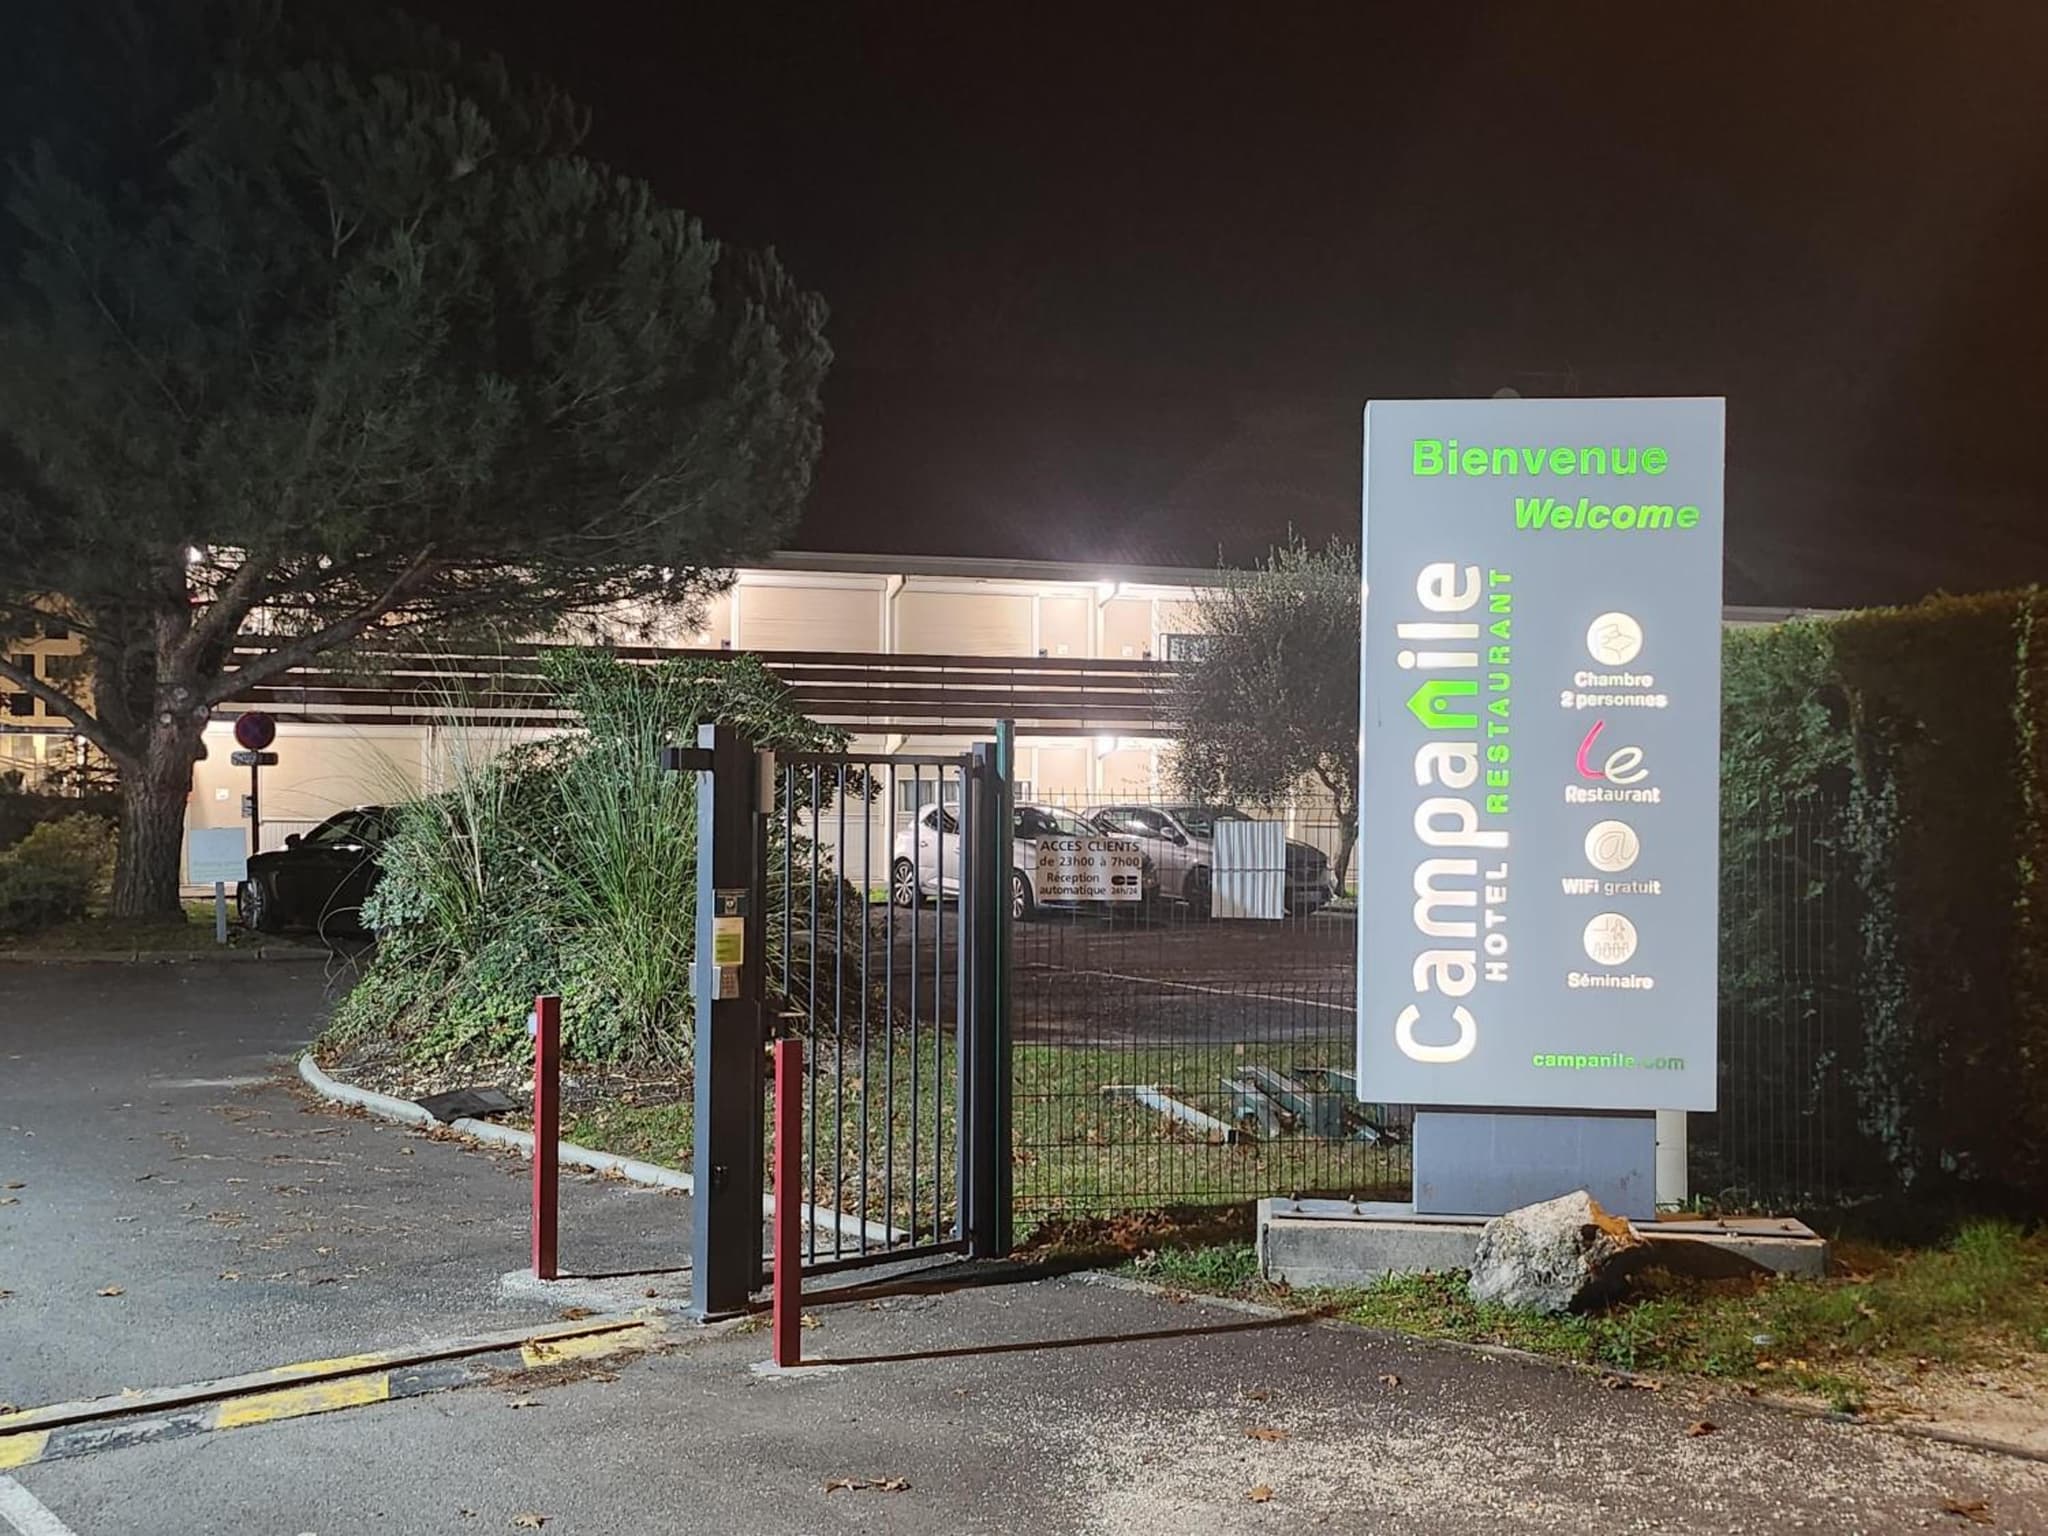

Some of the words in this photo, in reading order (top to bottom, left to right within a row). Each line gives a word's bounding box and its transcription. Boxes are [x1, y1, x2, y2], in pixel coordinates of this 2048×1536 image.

[1411, 439, 1669, 477] Bienvenue
[1514, 498, 1700, 530] Welcome
[1574, 671, 1654, 688] Chambre
[1485, 568, 1513, 814] RESTAURANT
[1560, 690, 1575, 708] 2
[1576, 693, 1669, 710] personnes
[1565, 785, 1662, 803] Restaurant
[1040, 840, 1082, 852] ACCES
[1087, 841, 1140, 853] CLIENTS
[1040, 856, 1055, 867] de
[1059, 856, 1095, 867] 23h00
[1111, 856, 1140, 867] 7h00
[1047, 872, 1100, 884] Réception
[1561, 878, 1600, 895] WiFi
[1604, 880, 1662, 896] gratuit
[1039, 885, 1107, 897] automatique
[1484, 862, 1509, 982] HOTEL
[1567, 971, 1654, 989] Séminaire
[1532, 1051, 1685, 1071] campanile.com
